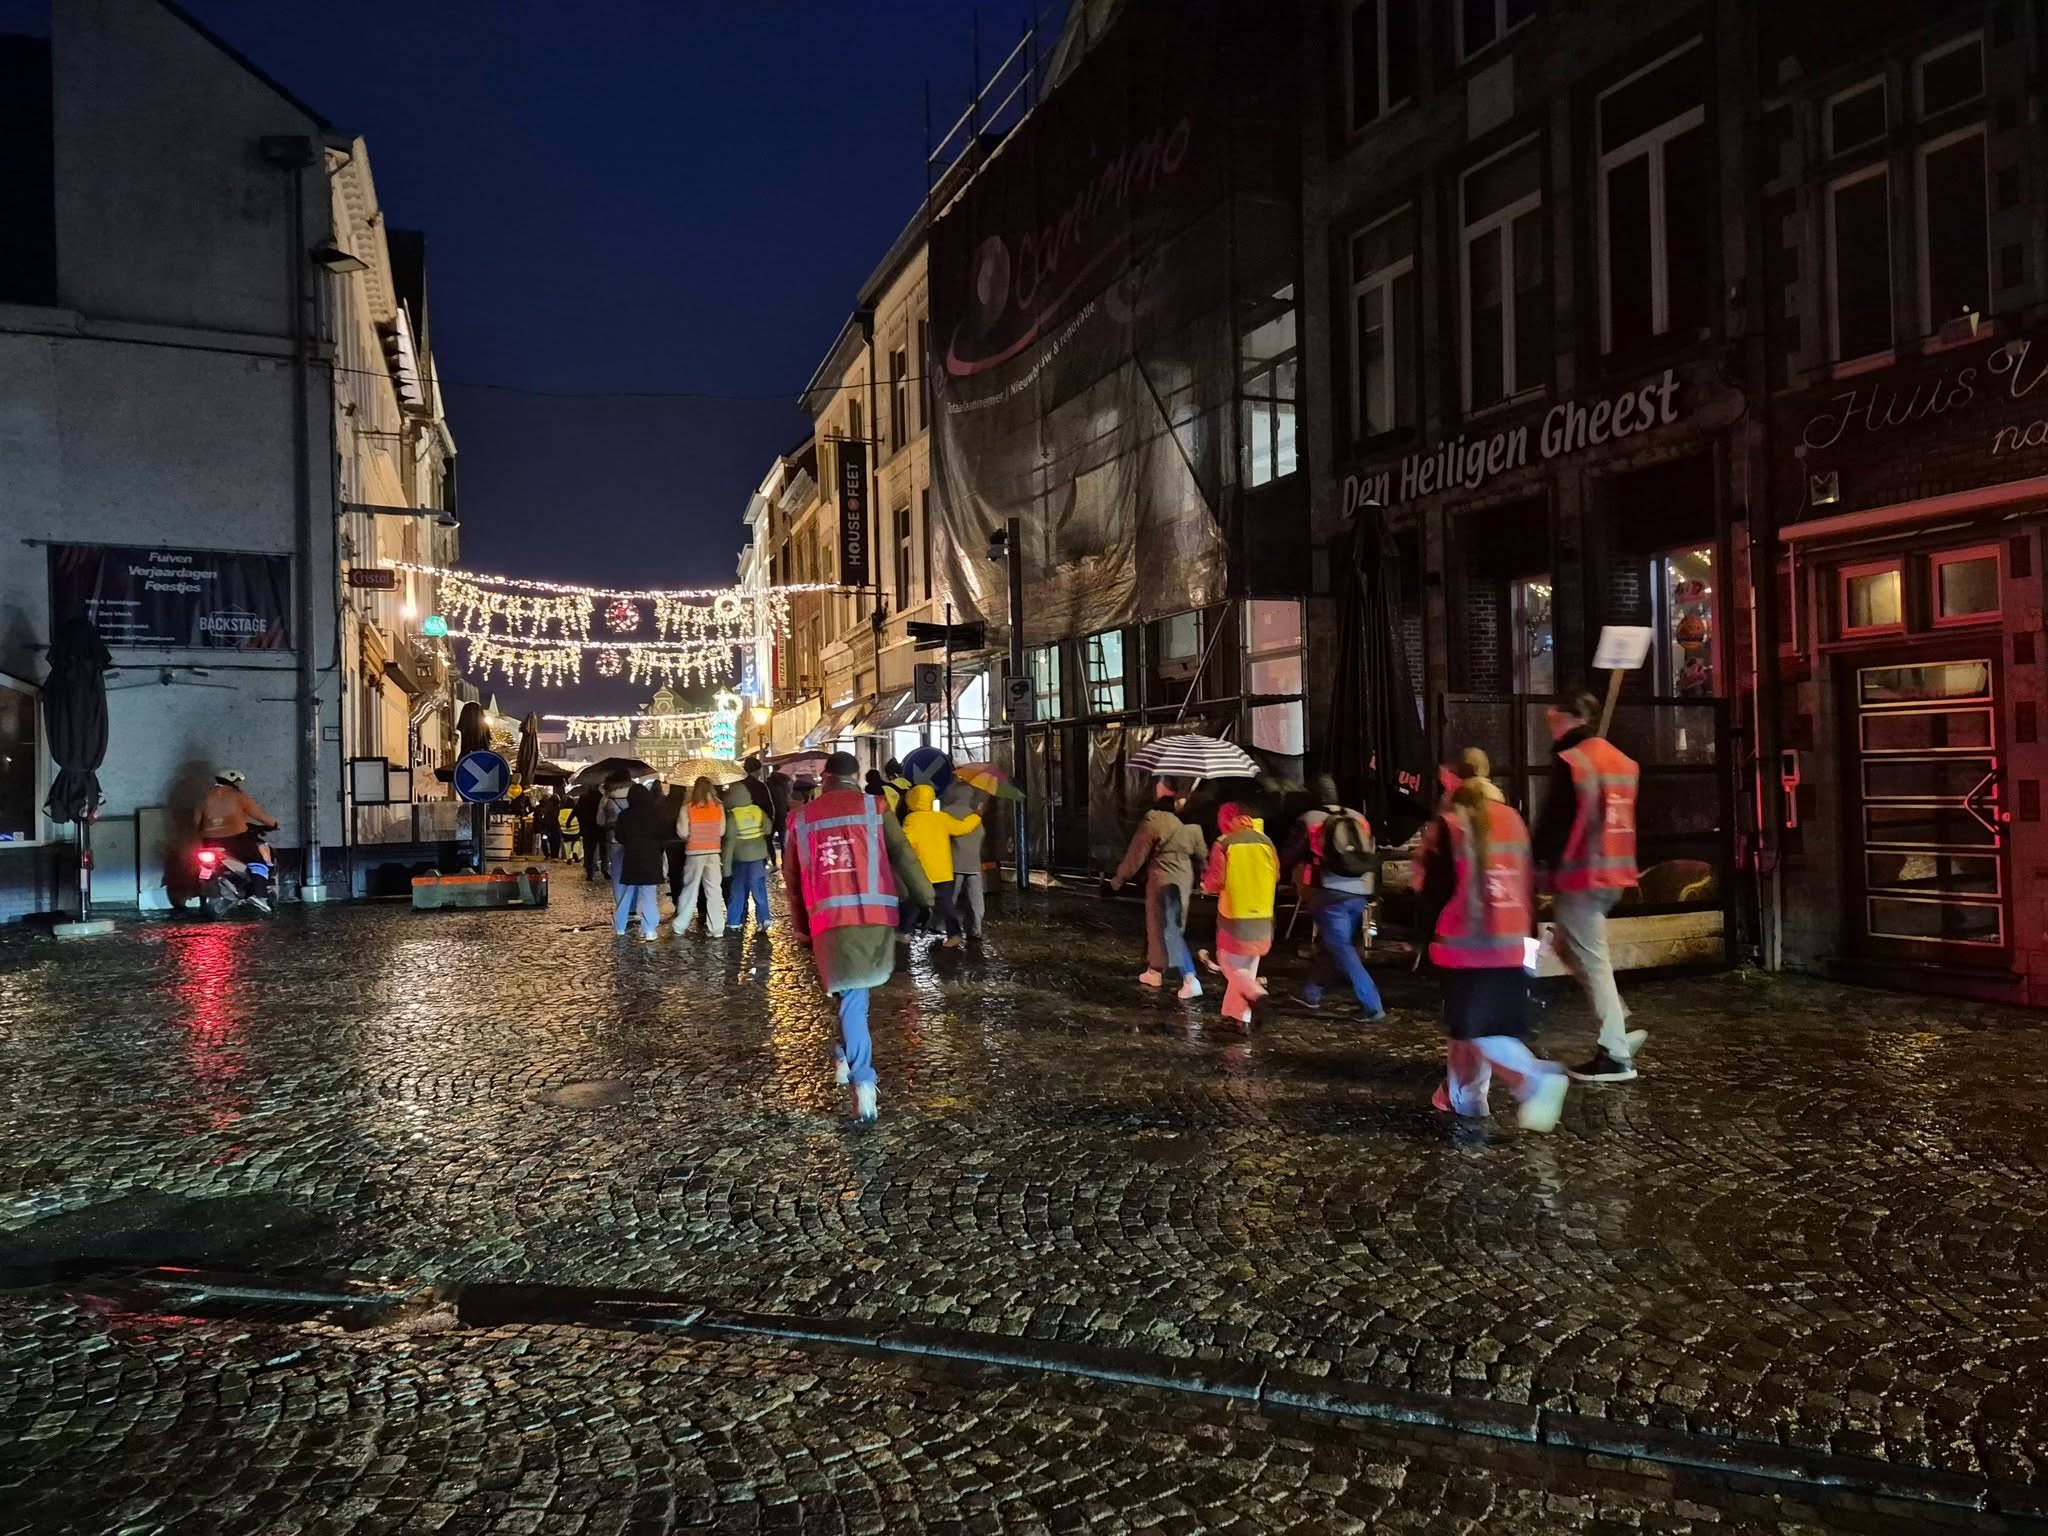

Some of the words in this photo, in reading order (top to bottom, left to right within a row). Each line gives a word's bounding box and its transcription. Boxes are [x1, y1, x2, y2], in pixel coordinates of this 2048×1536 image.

[1803, 367, 1977, 449] Huis
[1343, 472, 1390, 519] Den
[1400, 427, 1527, 502] Heiligen
[1540, 369, 1681, 458] Gheest
[847, 462, 859, 496] FEET
[848, 511, 860, 566] HOUSE
[149, 552, 193, 564] Fuiven
[128, 565, 217, 580] Verjaardagen
[353, 571, 389, 584] Cristal
[145, 581, 201, 594] Feestjes
[200, 617, 267, 632] BACKSTAGE
